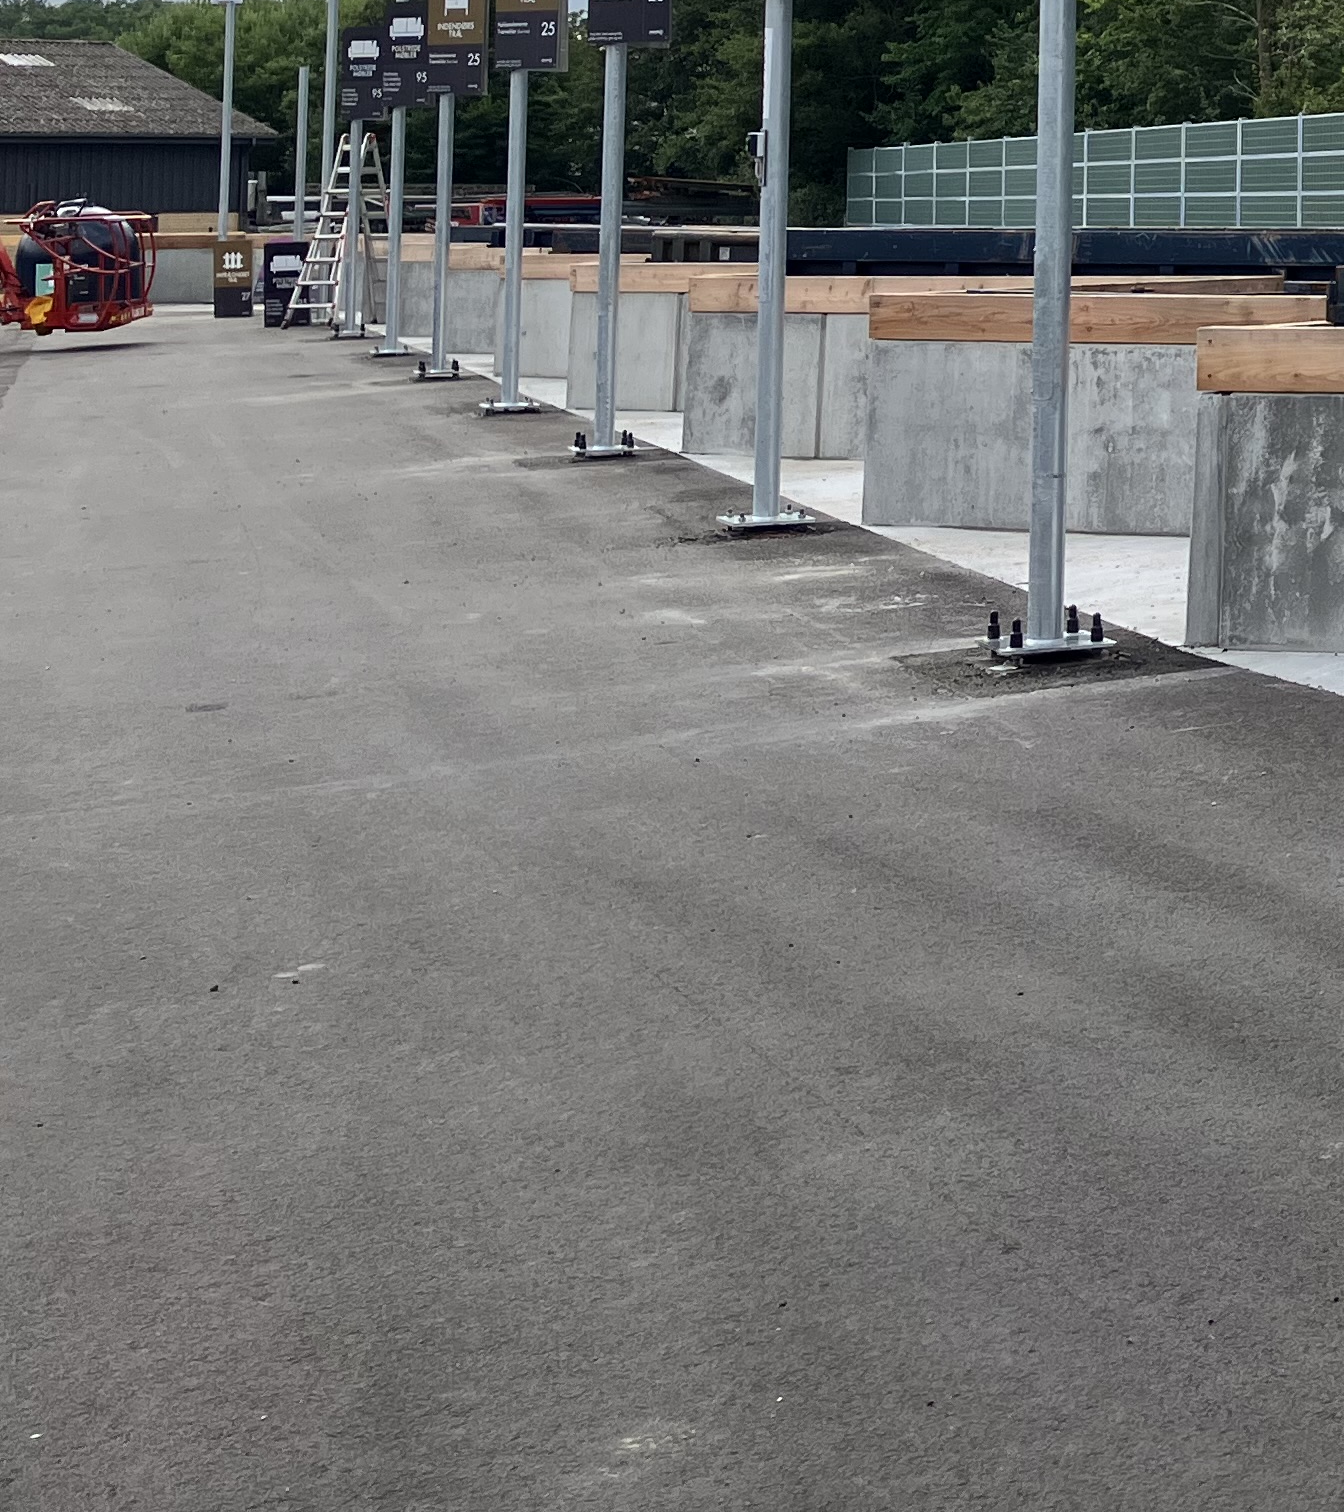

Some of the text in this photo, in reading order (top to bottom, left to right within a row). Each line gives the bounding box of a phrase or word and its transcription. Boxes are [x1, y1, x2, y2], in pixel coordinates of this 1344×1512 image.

[541, 21, 556, 36] 25
[467, 52, 480, 66] 25
[415, 71, 428, 83] 95
